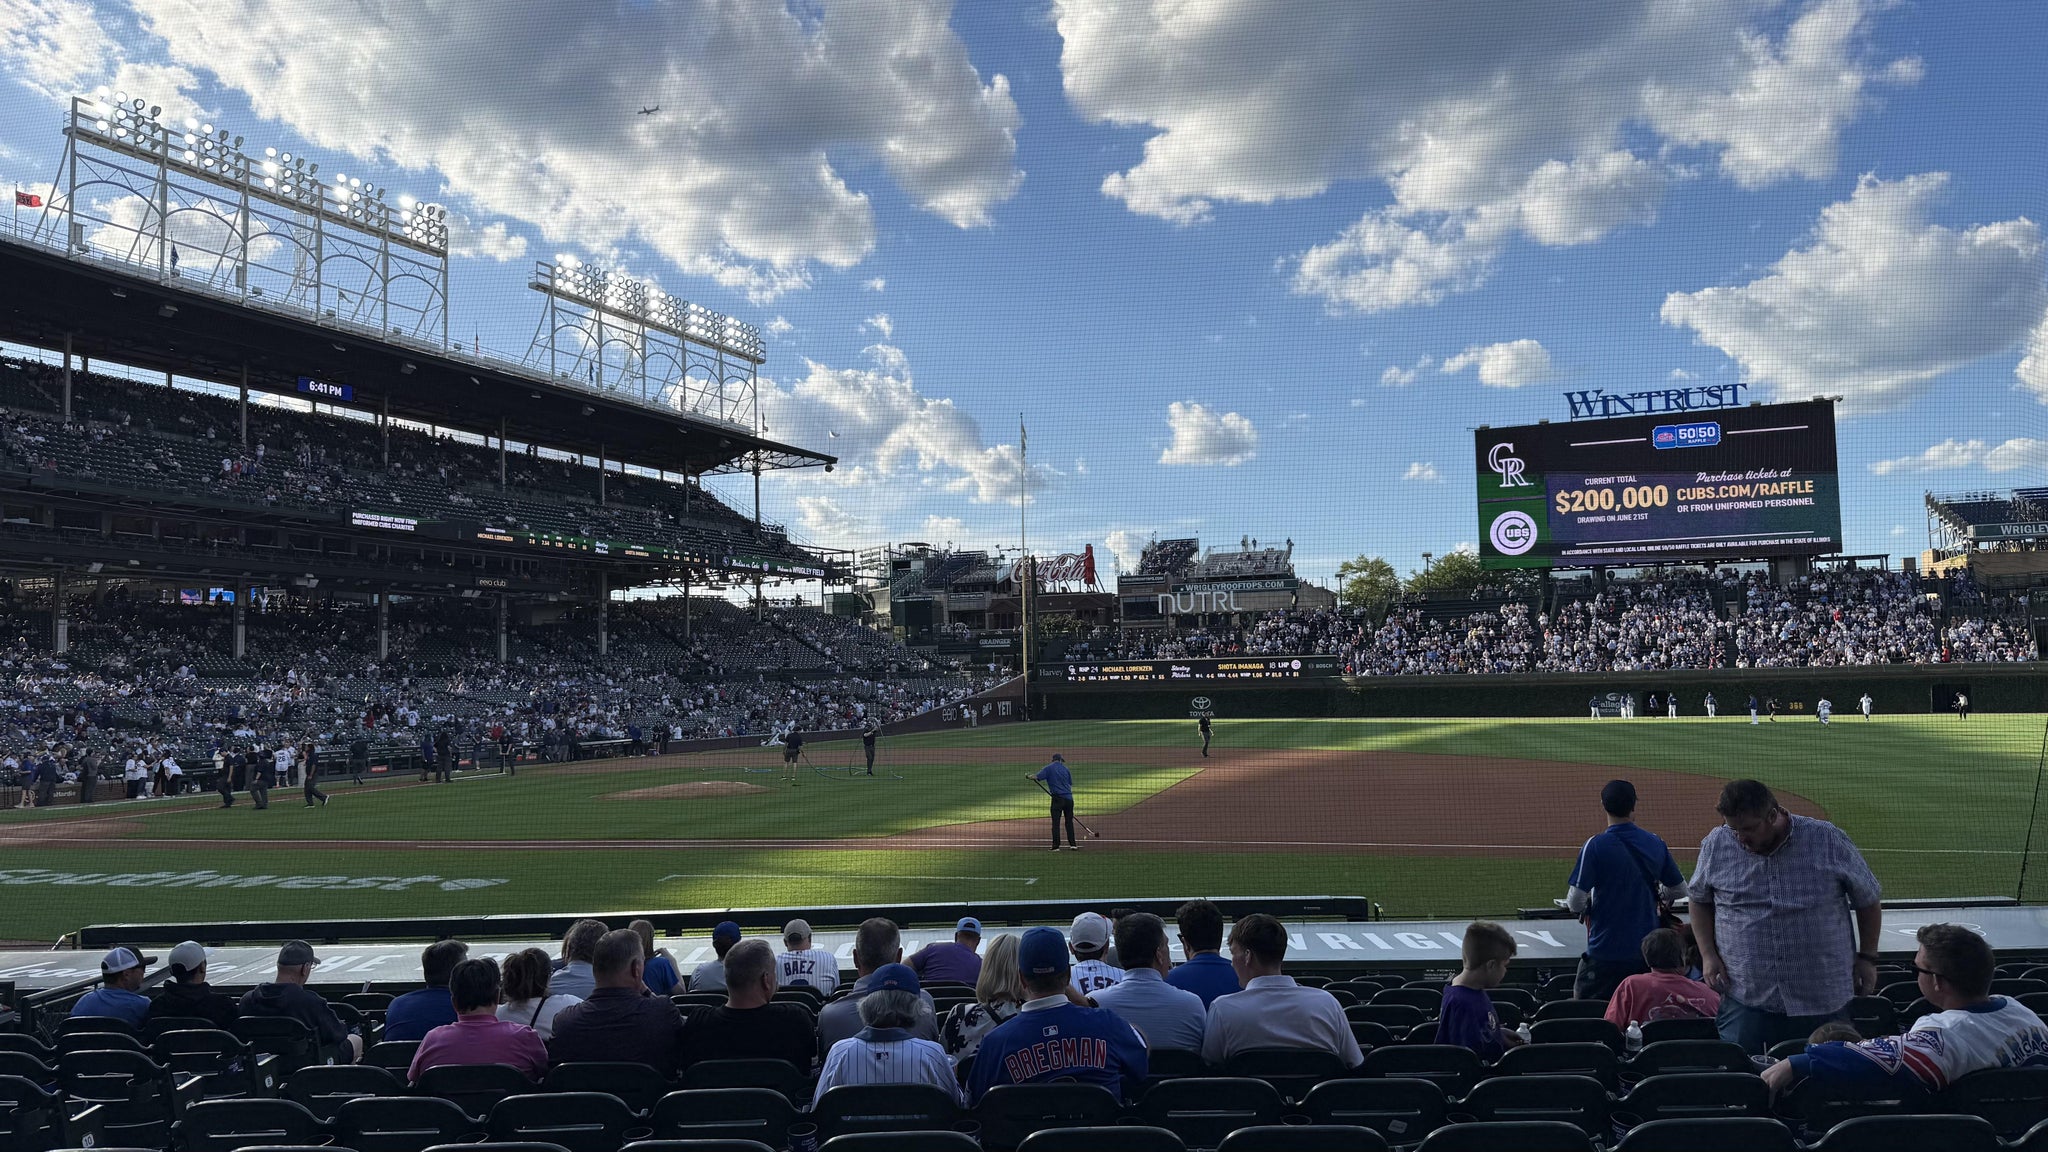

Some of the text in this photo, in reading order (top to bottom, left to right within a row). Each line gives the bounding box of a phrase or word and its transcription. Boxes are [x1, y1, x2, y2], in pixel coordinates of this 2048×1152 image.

[309, 381, 342, 397] 6:41 PM
[1563, 383, 1747, 418] WINTRUST
[1584, 475, 1637, 486] CURRENT TOTAL
[1695, 467, 1793, 483] Purchase tickets at
[1676, 480, 1814, 501] CUBS.COM/RAFFLE
[1555, 485, 1669, 515] $200,000
[1677, 497, 1815, 513] OR FROM UNIFORMED PERSONNEL
[352, 512, 380, 521] PURCHASED
[1577, 512, 1649, 524] DRAWING ON JUNE 21ST
[792, 566, 812, 575] WRIGLEY
[812, 568, 825, 577] FIELD
[1185, 581, 1285, 591] WRIGLEYROOFTOPS.COM
[1039, 668, 1064, 677] Harvey
[1171, 664, 1191, 673] Starting
[997, 700, 1012, 716] YETI
[783, 960, 816, 977] BAEZ
[1004, 1037, 1107, 1085] BREGMAN
